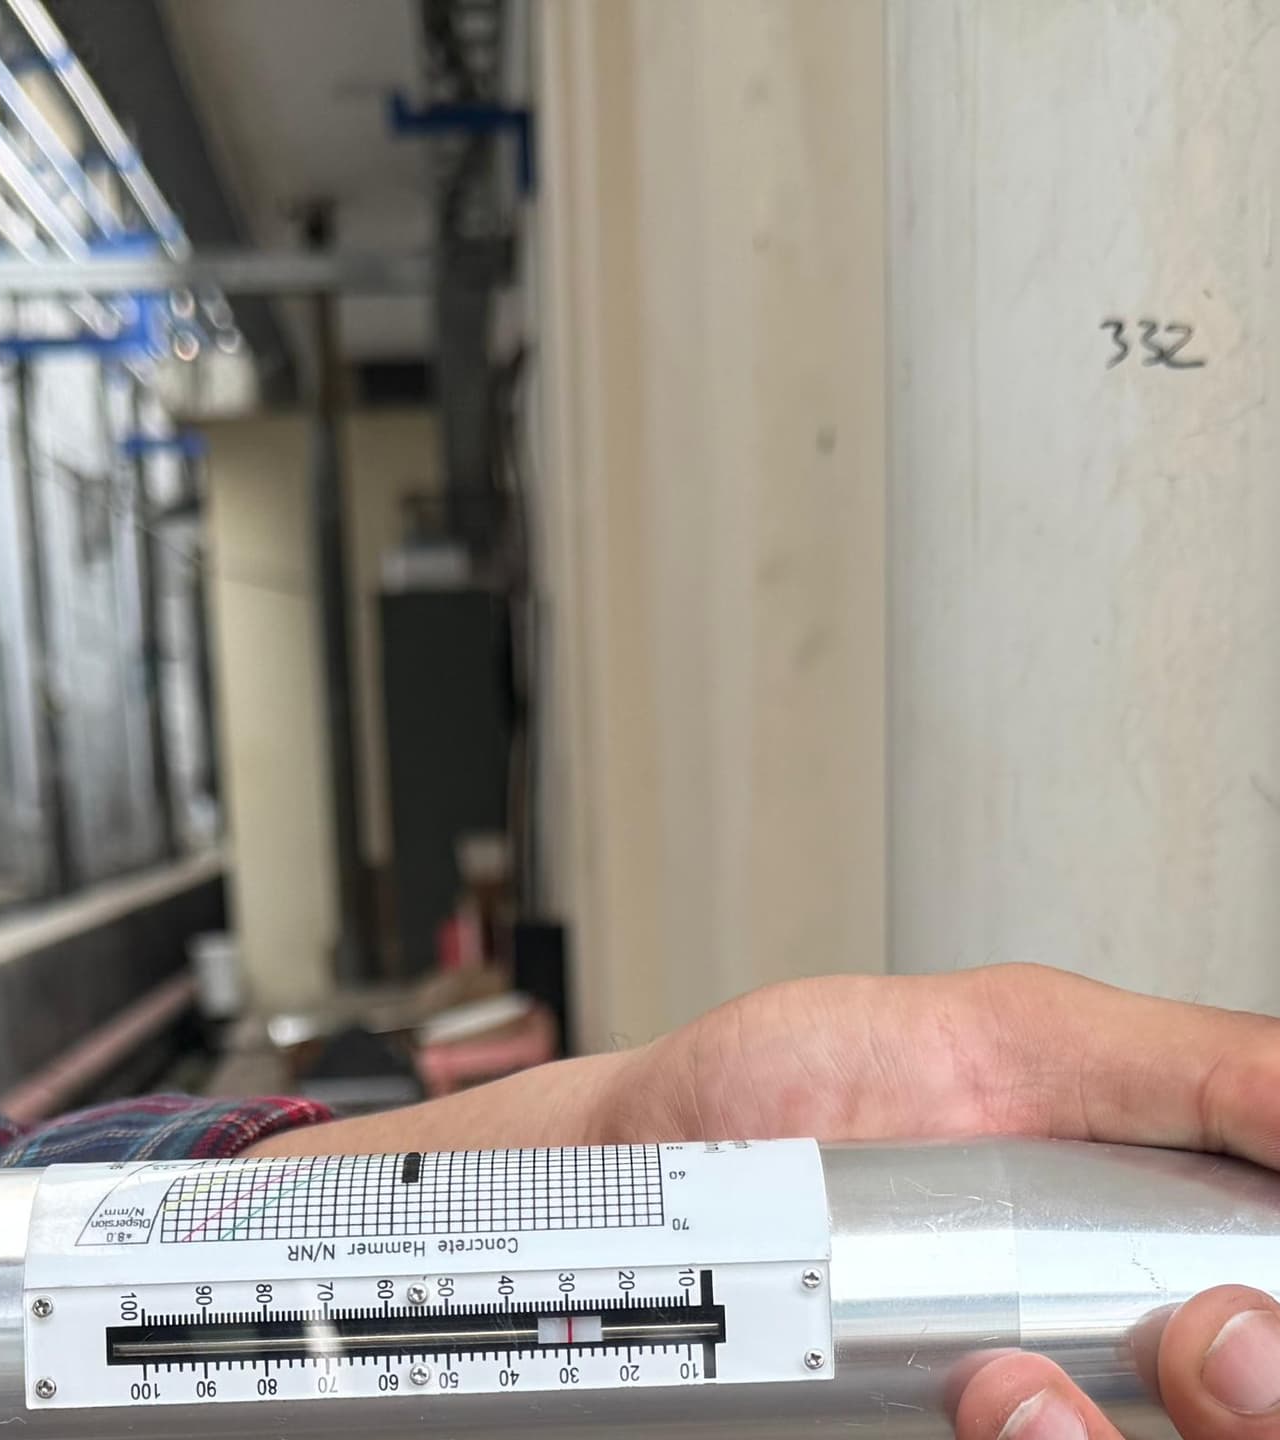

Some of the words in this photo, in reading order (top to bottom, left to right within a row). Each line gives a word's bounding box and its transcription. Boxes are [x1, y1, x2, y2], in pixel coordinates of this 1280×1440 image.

[1101, 319, 1206, 369] 332
[669, 1171, 685, 1179] 60
[673, 1218, 689, 1230] 70
[288, 1242, 335, 1262] N/NR
[347, 1241, 425, 1257] Hammer
[438, 1238, 518, 1254] Concrete
[498, 1275, 514, 1295] 40
[559, 1273, 575, 1292] 30
[619, 1271, 635, 1290] 20
[679, 1268, 695, 1286] 10
[196, 1286, 212, 1305] 90
[256, 1284, 272, 1303] 80
[317, 1282, 334, 1301] 70
[377, 1280, 393, 1299] 60
[437, 1278, 454, 1297] 50
[121, 1293, 138, 1320] 100
[499, 1370, 520, 1386] 40
[560, 1367, 579, 1383] 30
[620, 1365, 639, 1381] 20
[680, 1363, 699, 1379] 10
[257, 1379, 277, 1395] 80
[318, 1376, 338, 1393] 70
[379, 1374, 398, 1391] 60
[439, 1372, 458, 1388] 50
[131, 1383, 160, 1400] 100
[197, 1381, 216, 1397] 90
